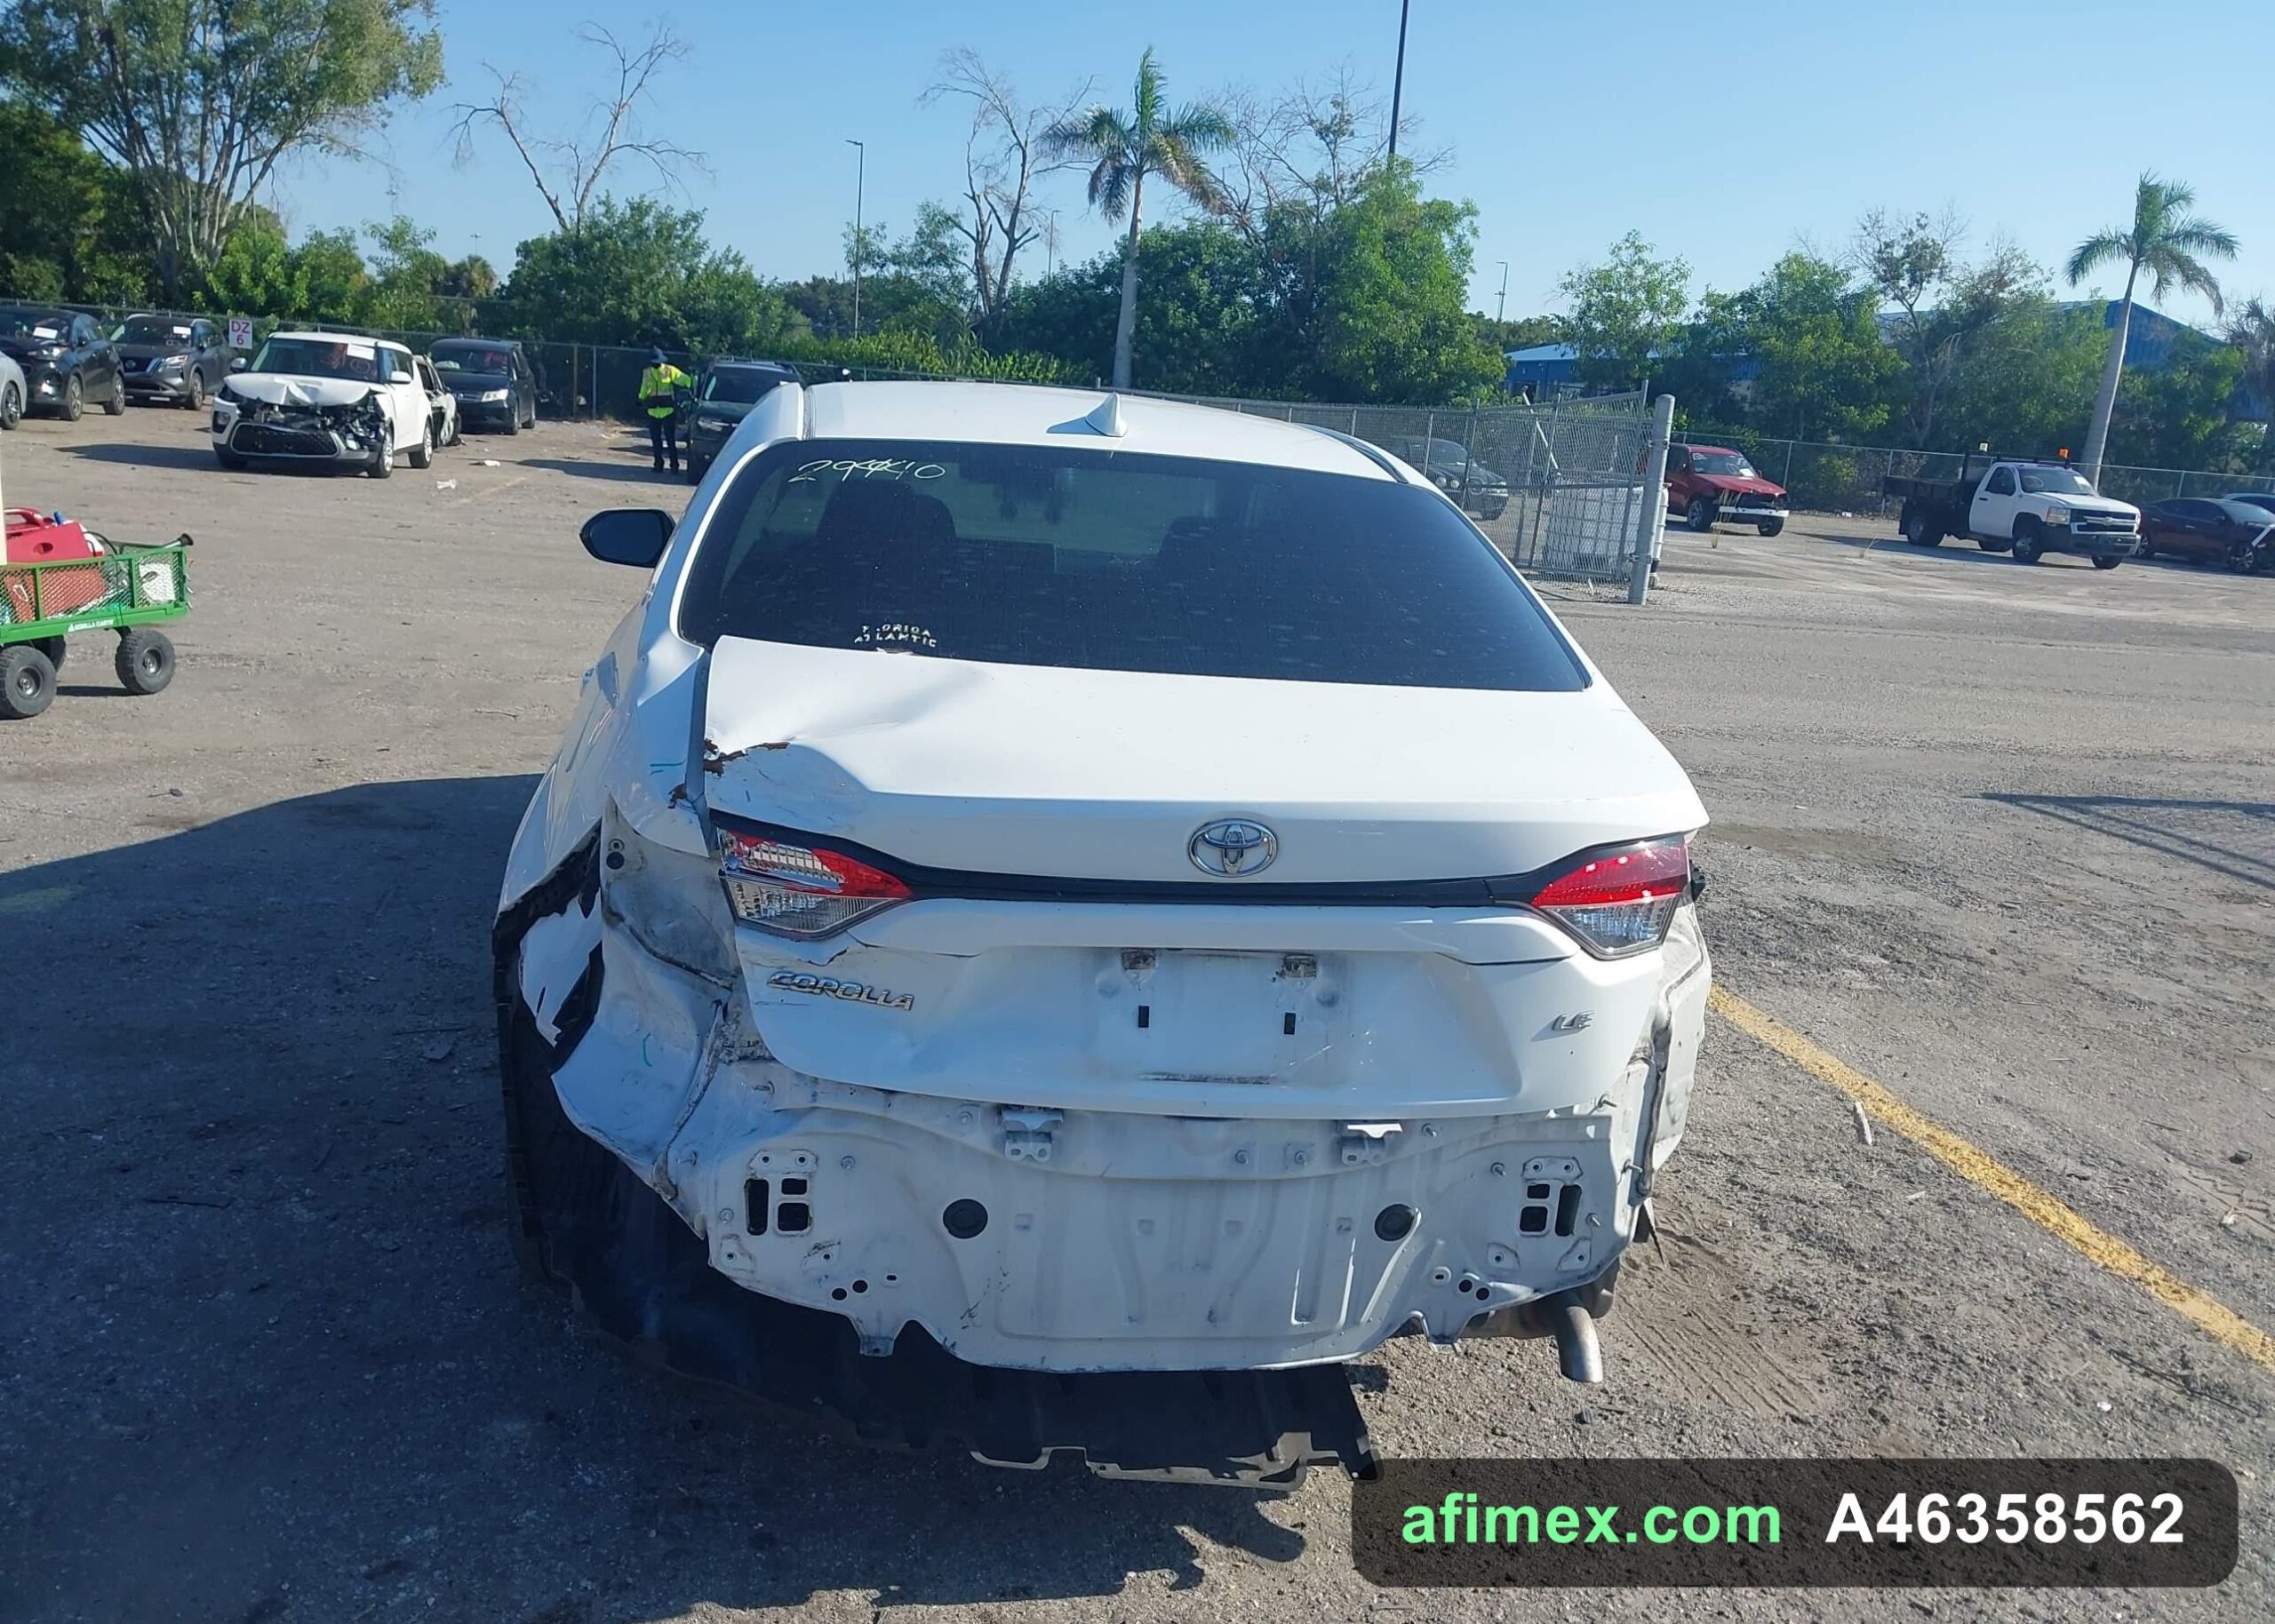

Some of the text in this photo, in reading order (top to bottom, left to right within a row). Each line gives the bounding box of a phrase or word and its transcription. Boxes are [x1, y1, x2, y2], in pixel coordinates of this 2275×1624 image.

[231, 321, 251, 334] DZ
[236, 334, 244, 346] 6
[767, 971, 915, 1011] COROLLA
[1552, 1012, 1593, 1032] LE
